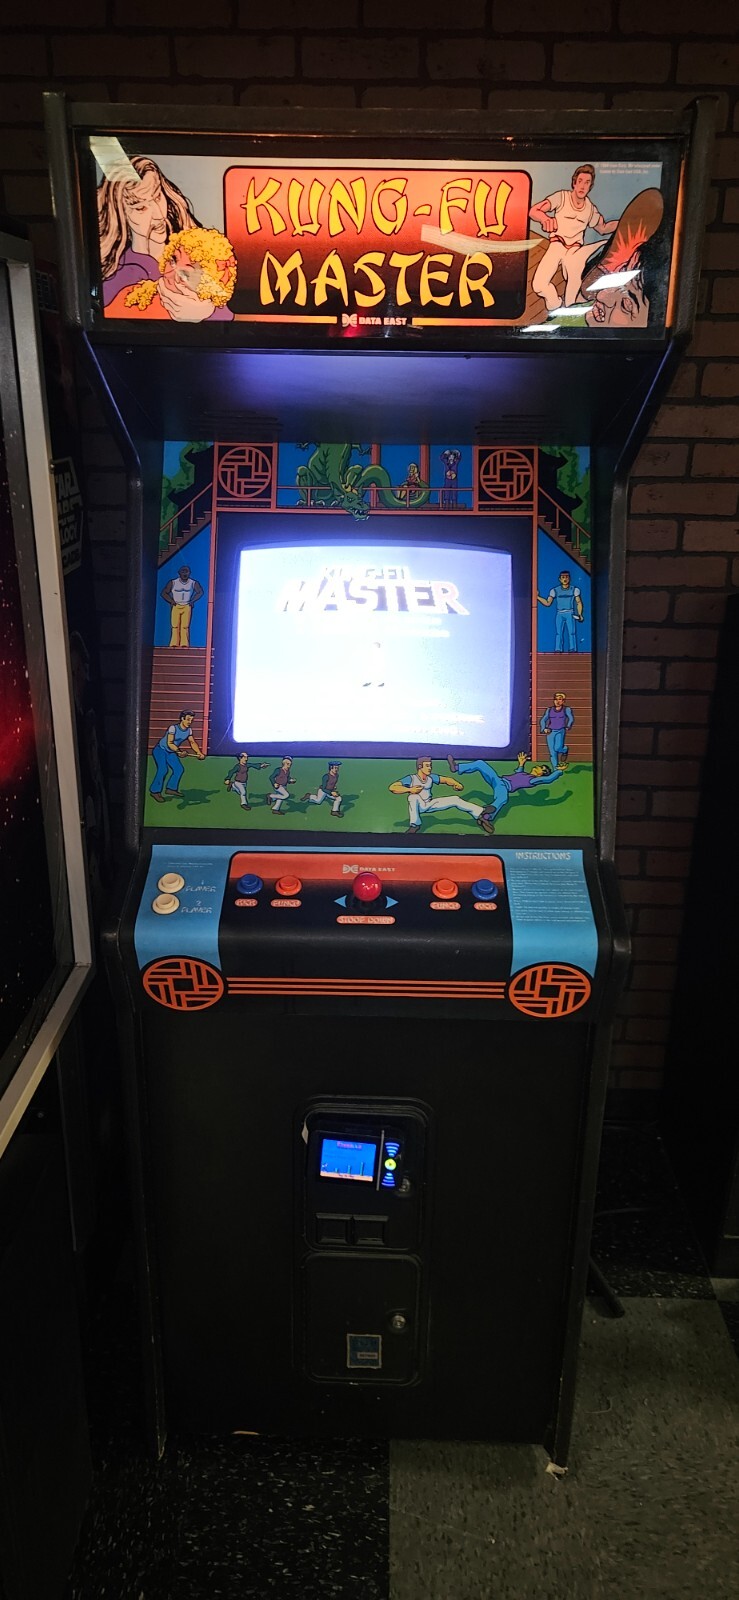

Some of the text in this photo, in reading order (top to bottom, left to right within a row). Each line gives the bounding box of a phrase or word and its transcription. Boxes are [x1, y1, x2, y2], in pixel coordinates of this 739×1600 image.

[241, 176, 513, 237] KUNG-FU
[259, 248, 496, 308] MASTER
[358, 316, 382, 325] DATA
[383, 317, 407, 326] EAST
[277, 578, 470, 616] MASTER
[515, 852, 572, 861] INSTRUCTIONS
